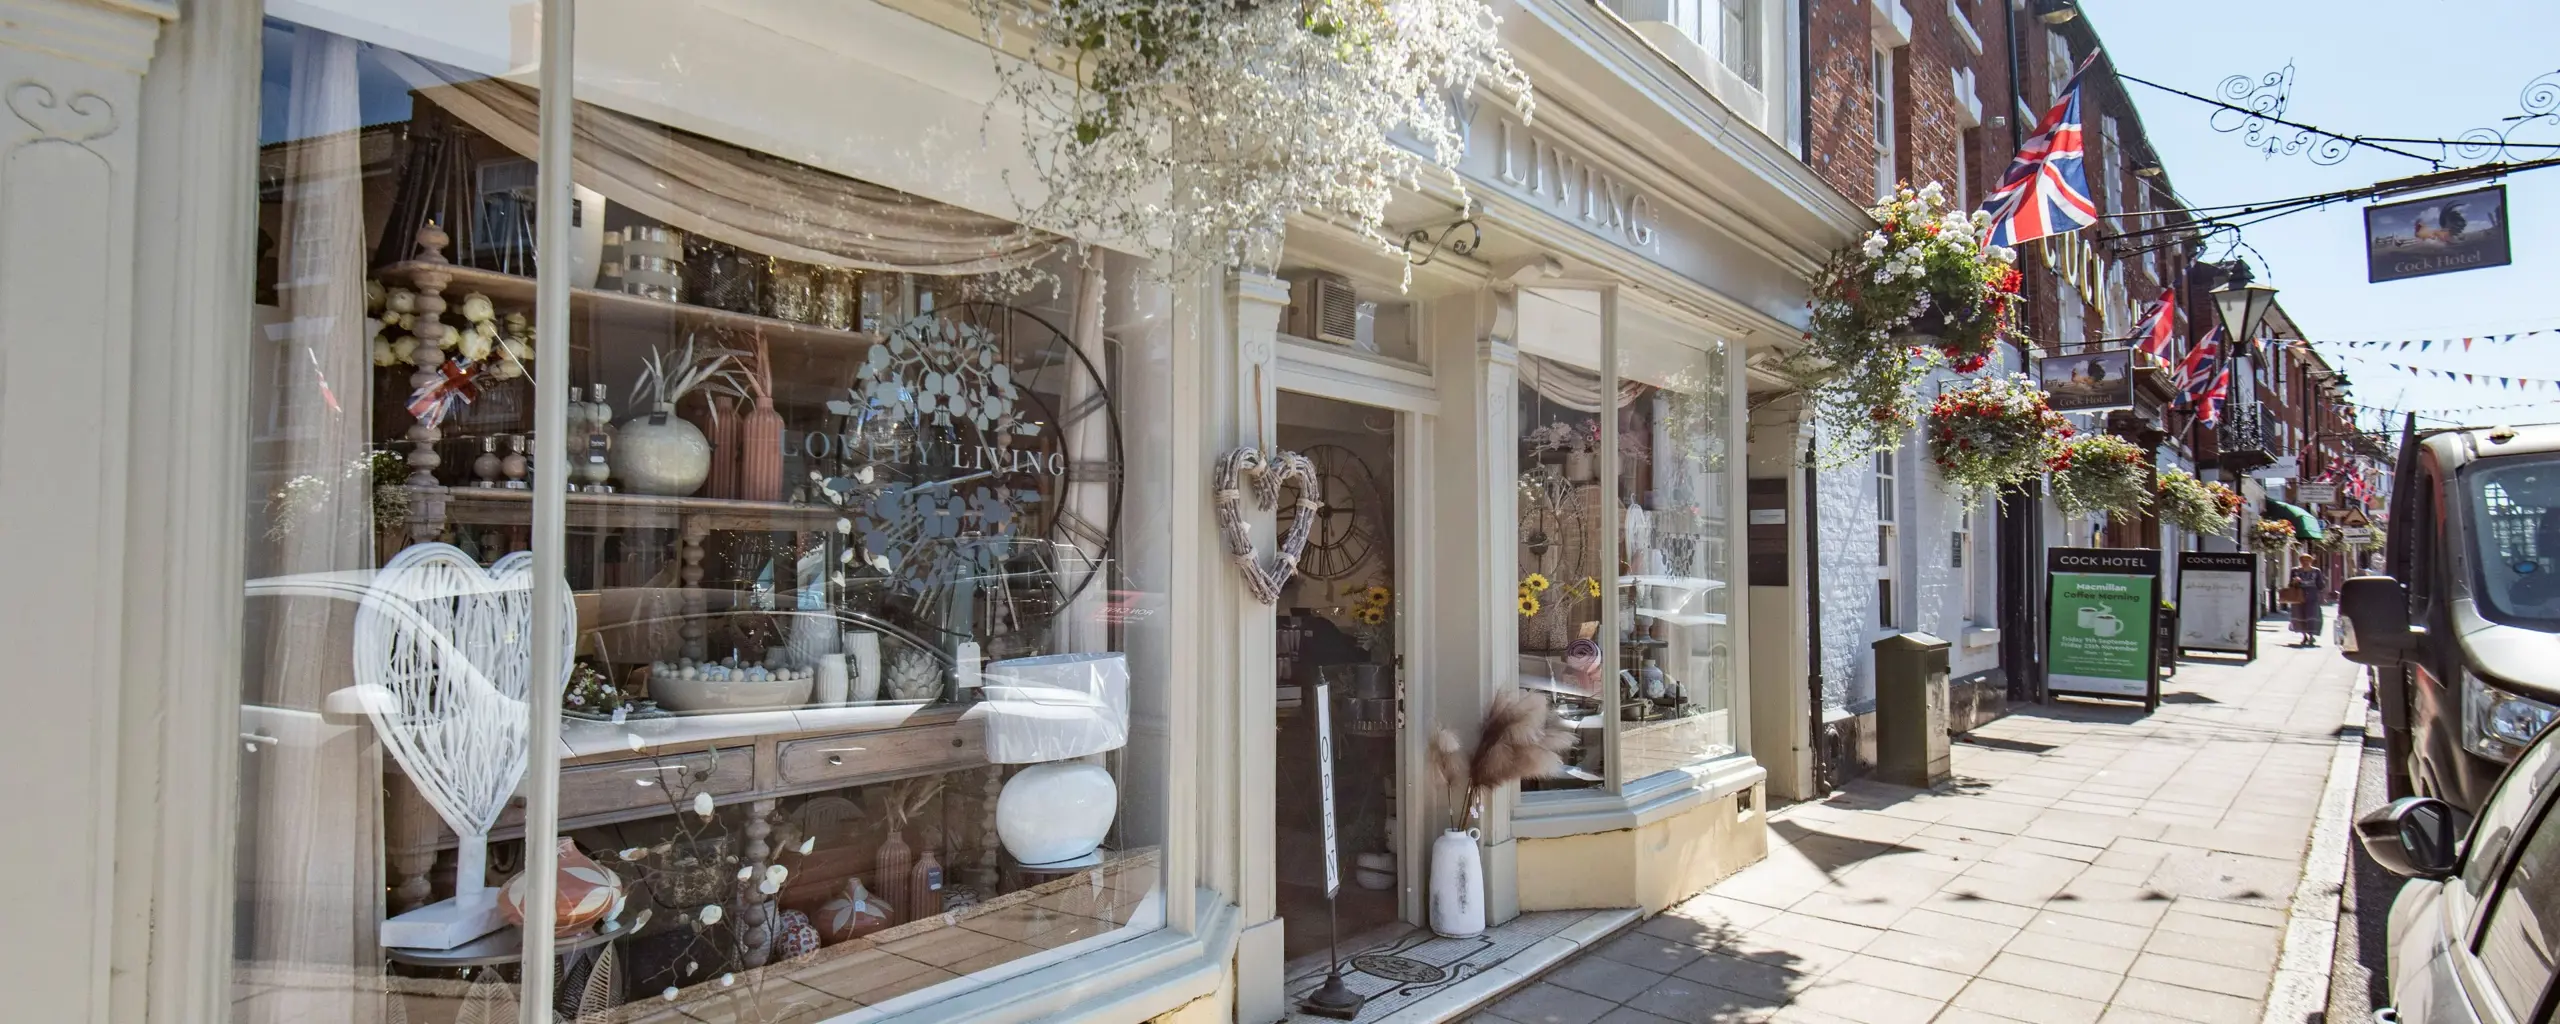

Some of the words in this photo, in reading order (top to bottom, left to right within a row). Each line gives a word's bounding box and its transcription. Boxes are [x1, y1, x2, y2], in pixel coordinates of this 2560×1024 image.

[1501, 118, 1652, 246] LIVING
[2394, 259, 2433, 273] Cock
[2436, 250, 2482, 268] Hotel
[2040, 230, 2106, 320] COCK
[2060, 396, 2084, 407] Cock
[2085, 394, 2113, 405] Hotel
[953, 443, 1066, 476] LIVING
[2060, 556, 2099, 566] COCK
[2102, 557, 2147, 567] HOTEL
[2186, 556, 2214, 564] COCK
[2215, 557, 2248, 565] HOTEL
[2063, 591, 2096, 599] Coffee
[2098, 592, 2140, 602] Morning
[2076, 583, 2127, 592] Macmillan
[1321, 736, 1337, 881] OPEN
